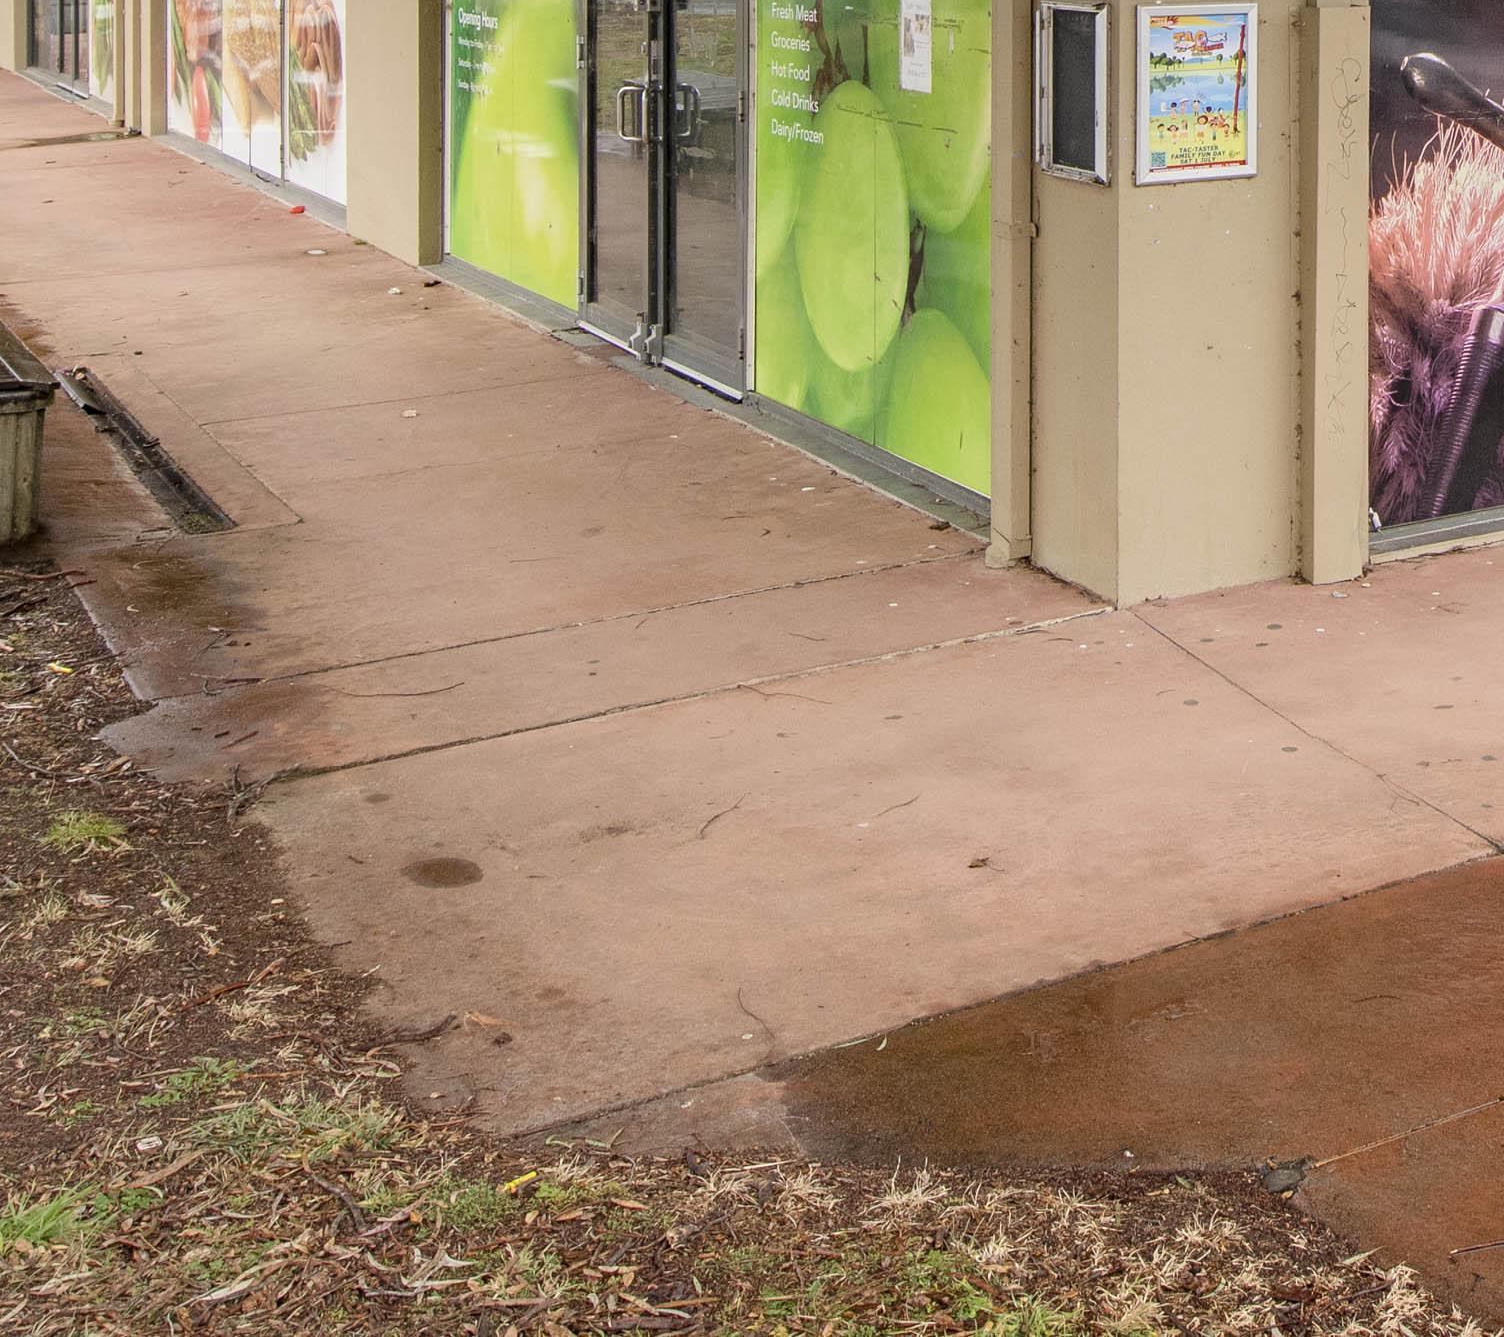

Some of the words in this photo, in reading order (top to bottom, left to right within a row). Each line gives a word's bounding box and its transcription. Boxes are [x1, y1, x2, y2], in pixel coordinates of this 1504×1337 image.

[458, 7, 481, 30] Opening
[482, 11, 498, 30] Hours
[772, 2, 793, 19] Fresh
[796, 5, 817, 22] Meat
[772, 31, 810, 51] Groceries
[772, 60, 786, 77] Hot
[788, 63, 810, 81] Food
[772, 89, 791, 107] Cold
[793, 93, 818, 112] Drinks
[772, 118, 824, 144] Dairy/Frozen
